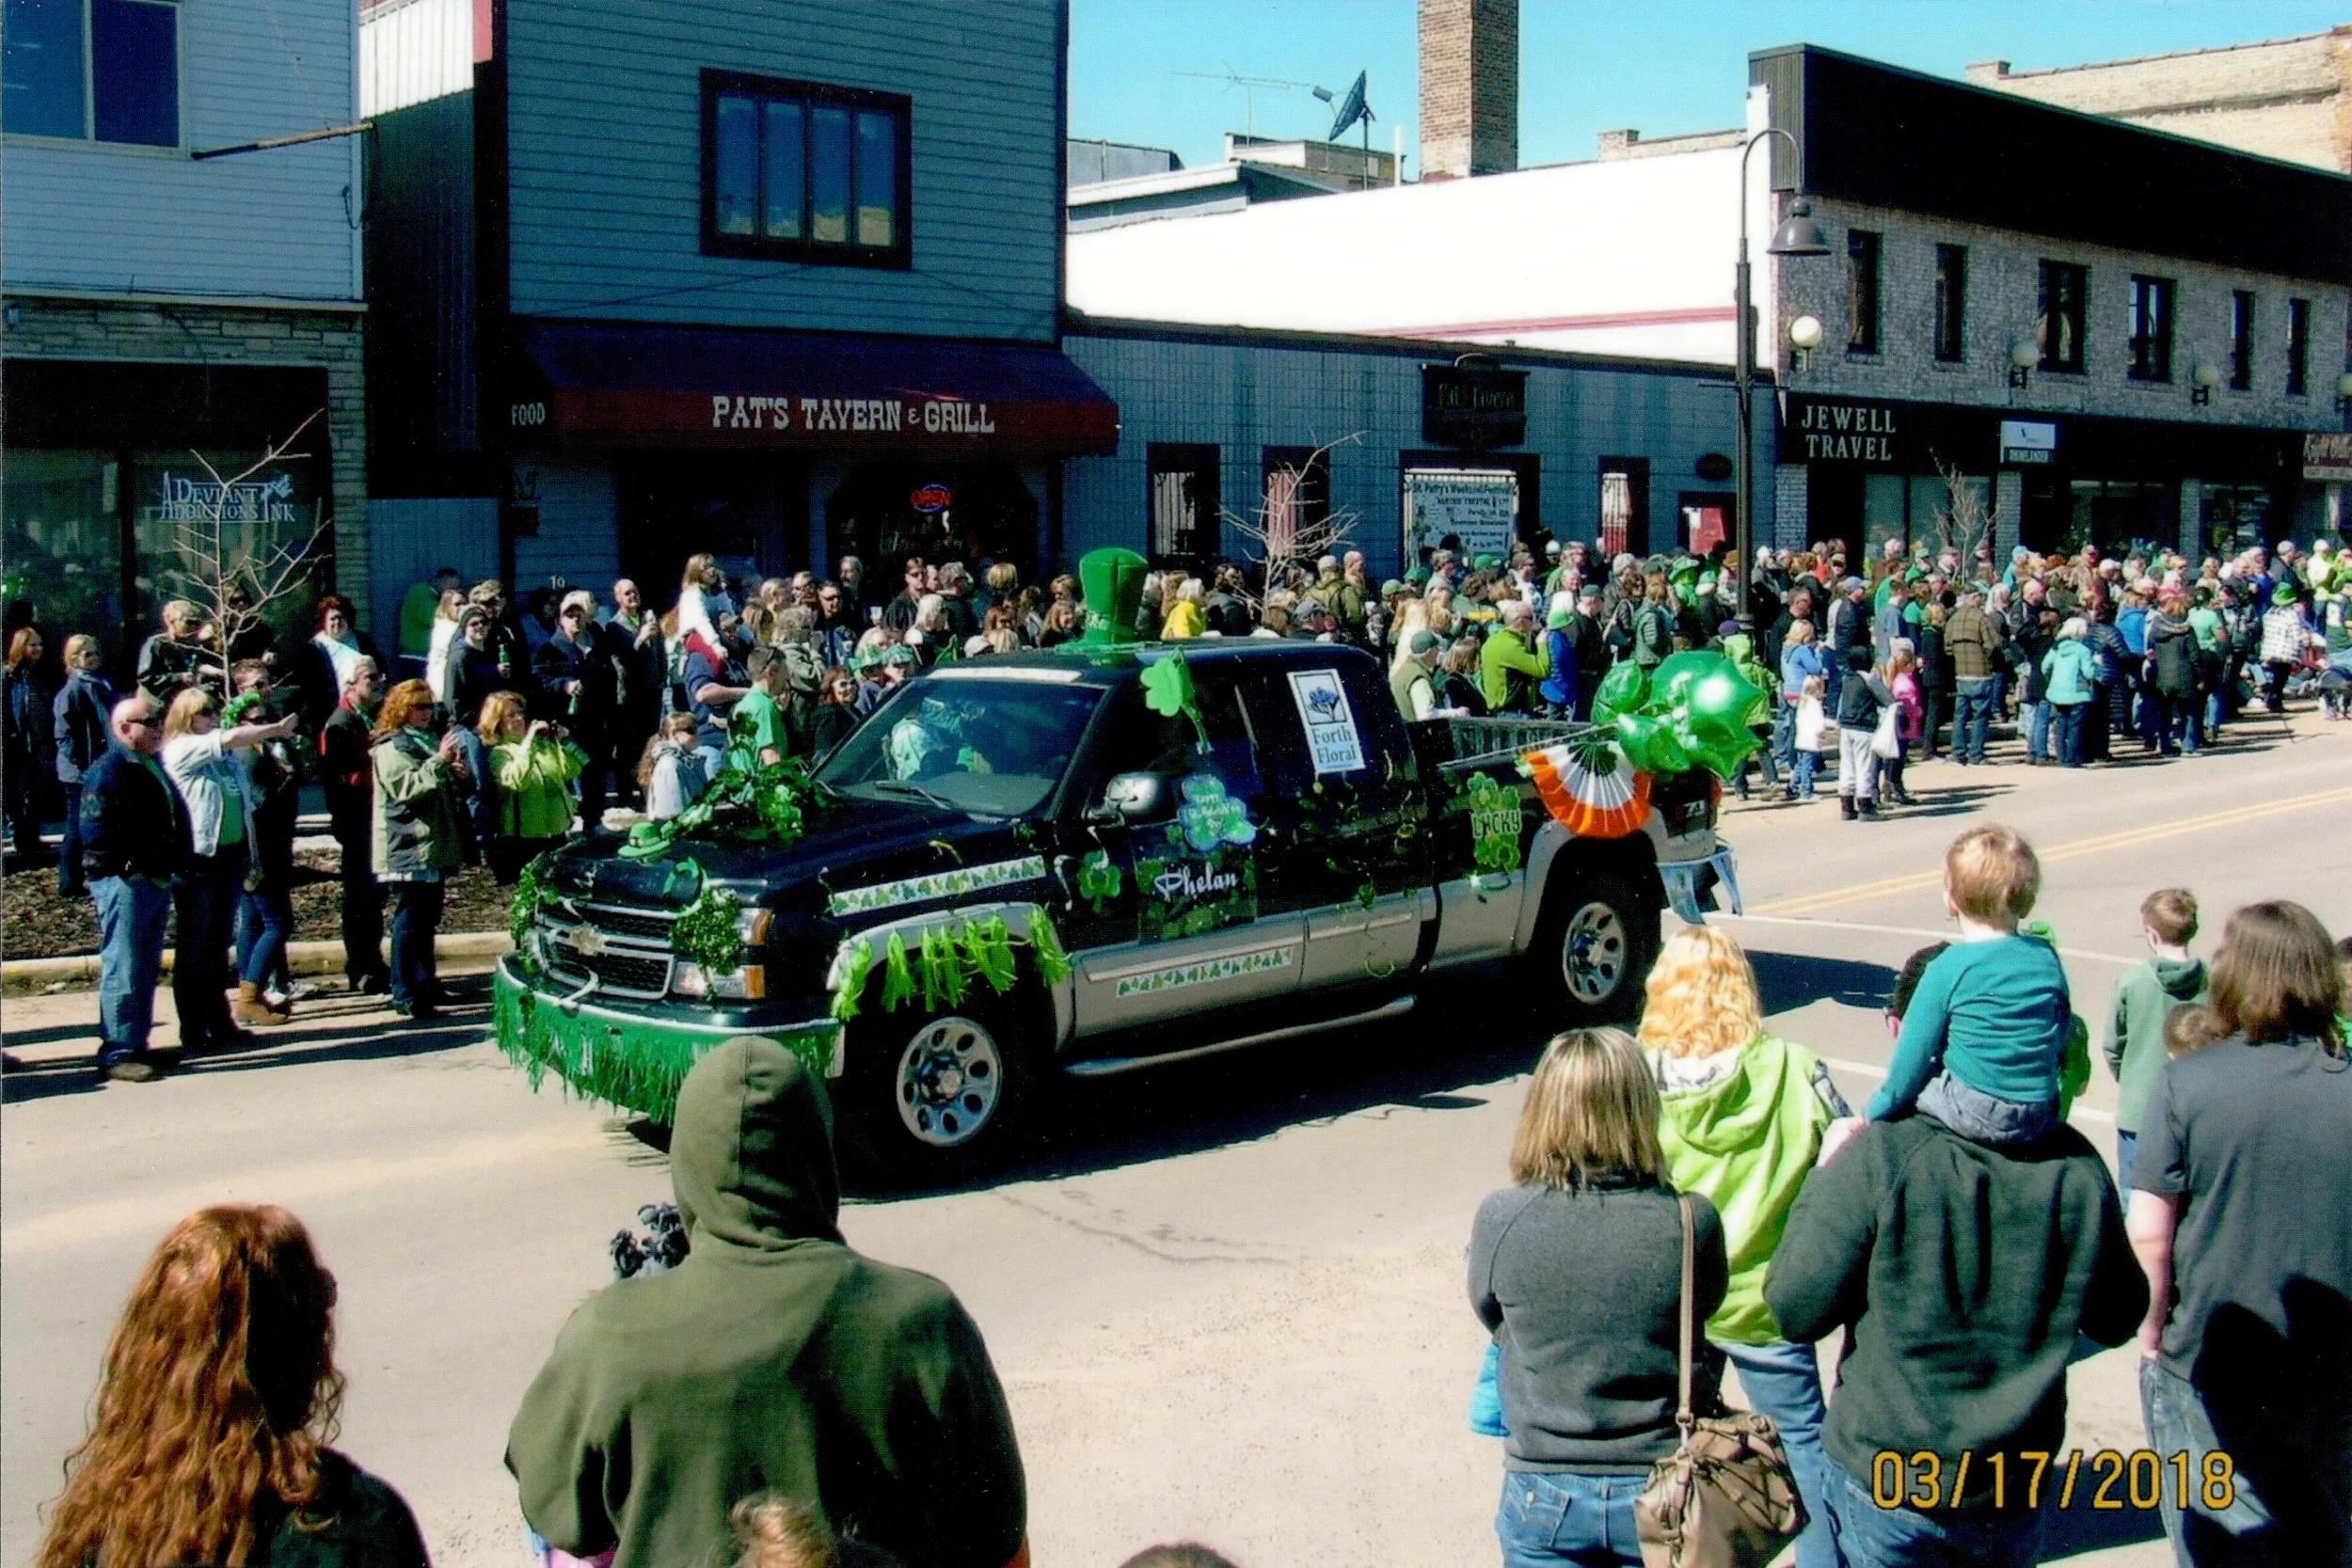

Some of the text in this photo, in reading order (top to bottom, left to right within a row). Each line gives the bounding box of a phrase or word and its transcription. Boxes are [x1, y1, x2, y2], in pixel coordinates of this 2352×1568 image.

[511, 403, 546, 425] FOOD
[712, 396, 995, 433] PAT'S TAVERN & GRILL
[1801, 405, 1897, 433] JEWELL
[1805, 434, 1892, 461] TRAVEL
[1311, 725, 1352, 744] Forth
[1317, 745, 1357, 763] Floral
[1473, 810, 1521, 837] LUCKY
[1153, 862, 1240, 902] Phelan
